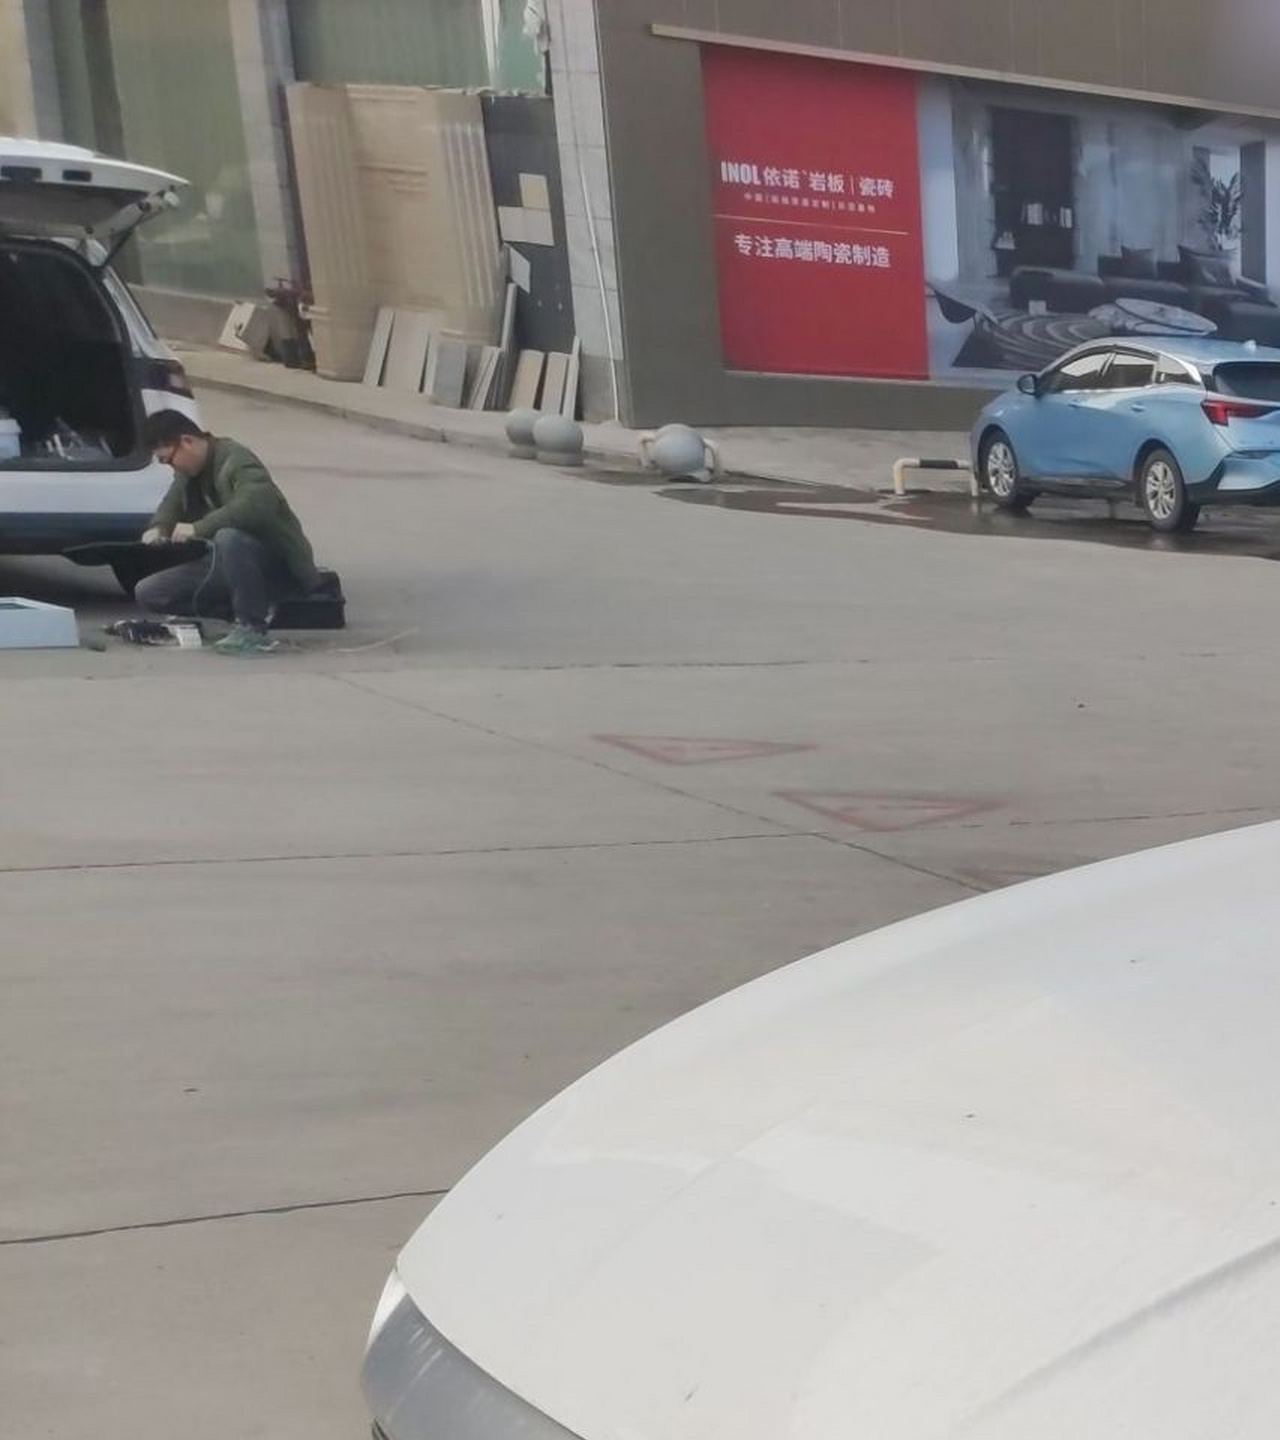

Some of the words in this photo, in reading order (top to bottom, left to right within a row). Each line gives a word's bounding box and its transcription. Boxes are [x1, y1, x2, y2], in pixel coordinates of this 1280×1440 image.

[720, 161, 760, 186] INOL
[763, 166, 800, 190] 依诺
[809, 173, 844, 194] 岩板
[859, 178, 893, 198] 瓷砖
[734, 234, 891, 268] 专注高端陶瓷制造
